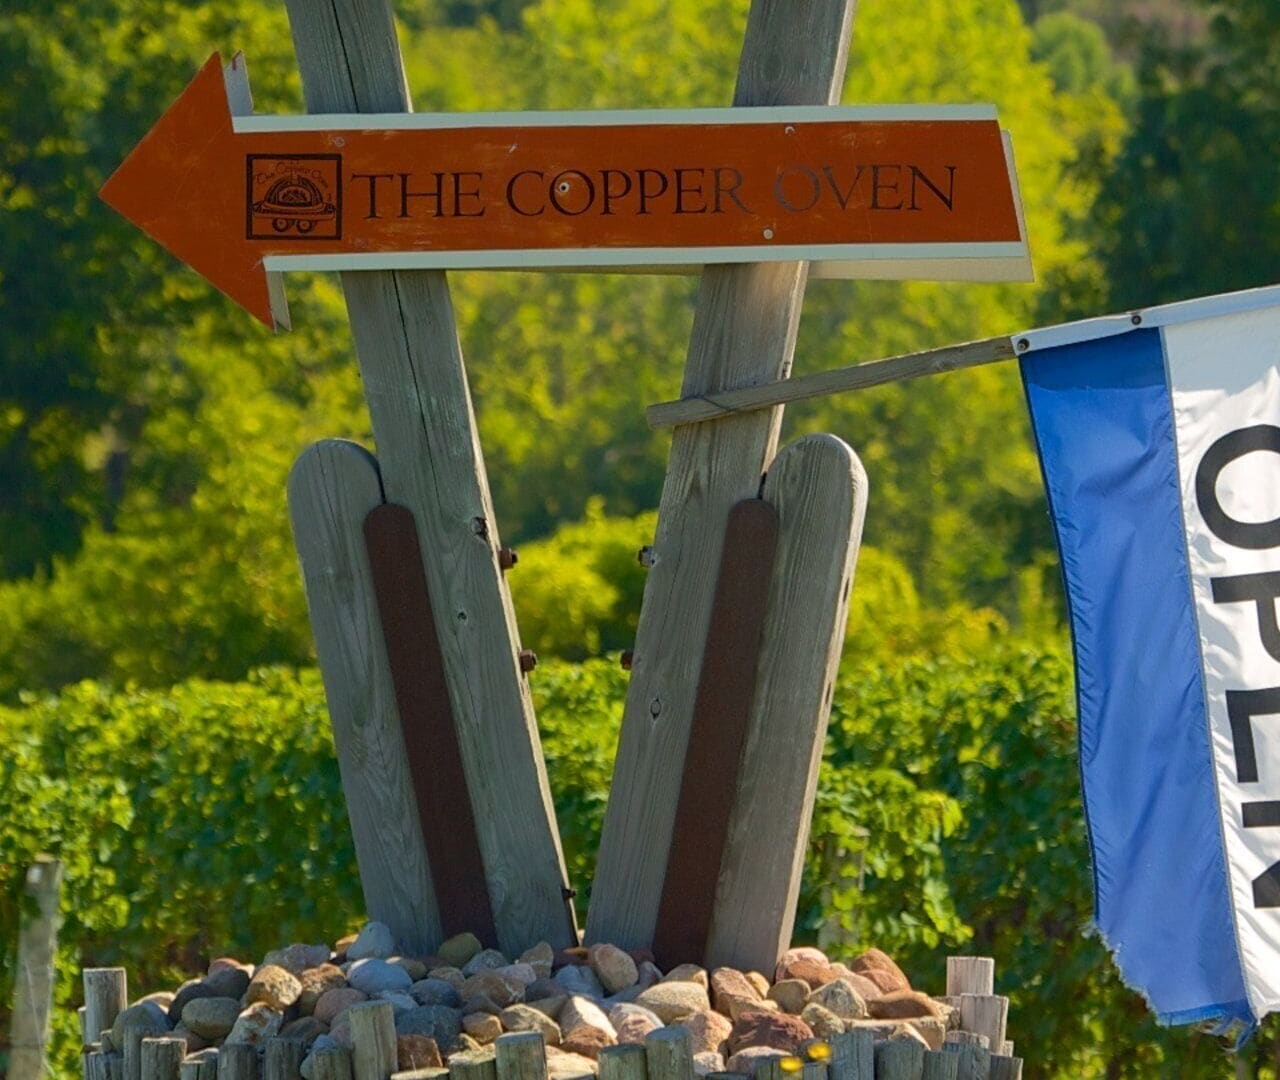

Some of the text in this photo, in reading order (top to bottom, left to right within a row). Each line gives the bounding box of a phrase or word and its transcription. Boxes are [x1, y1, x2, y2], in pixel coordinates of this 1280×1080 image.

[350, 170, 487, 222] THE
[505, 167, 754, 218] COPPER
[773, 163, 958, 214] OVEN
